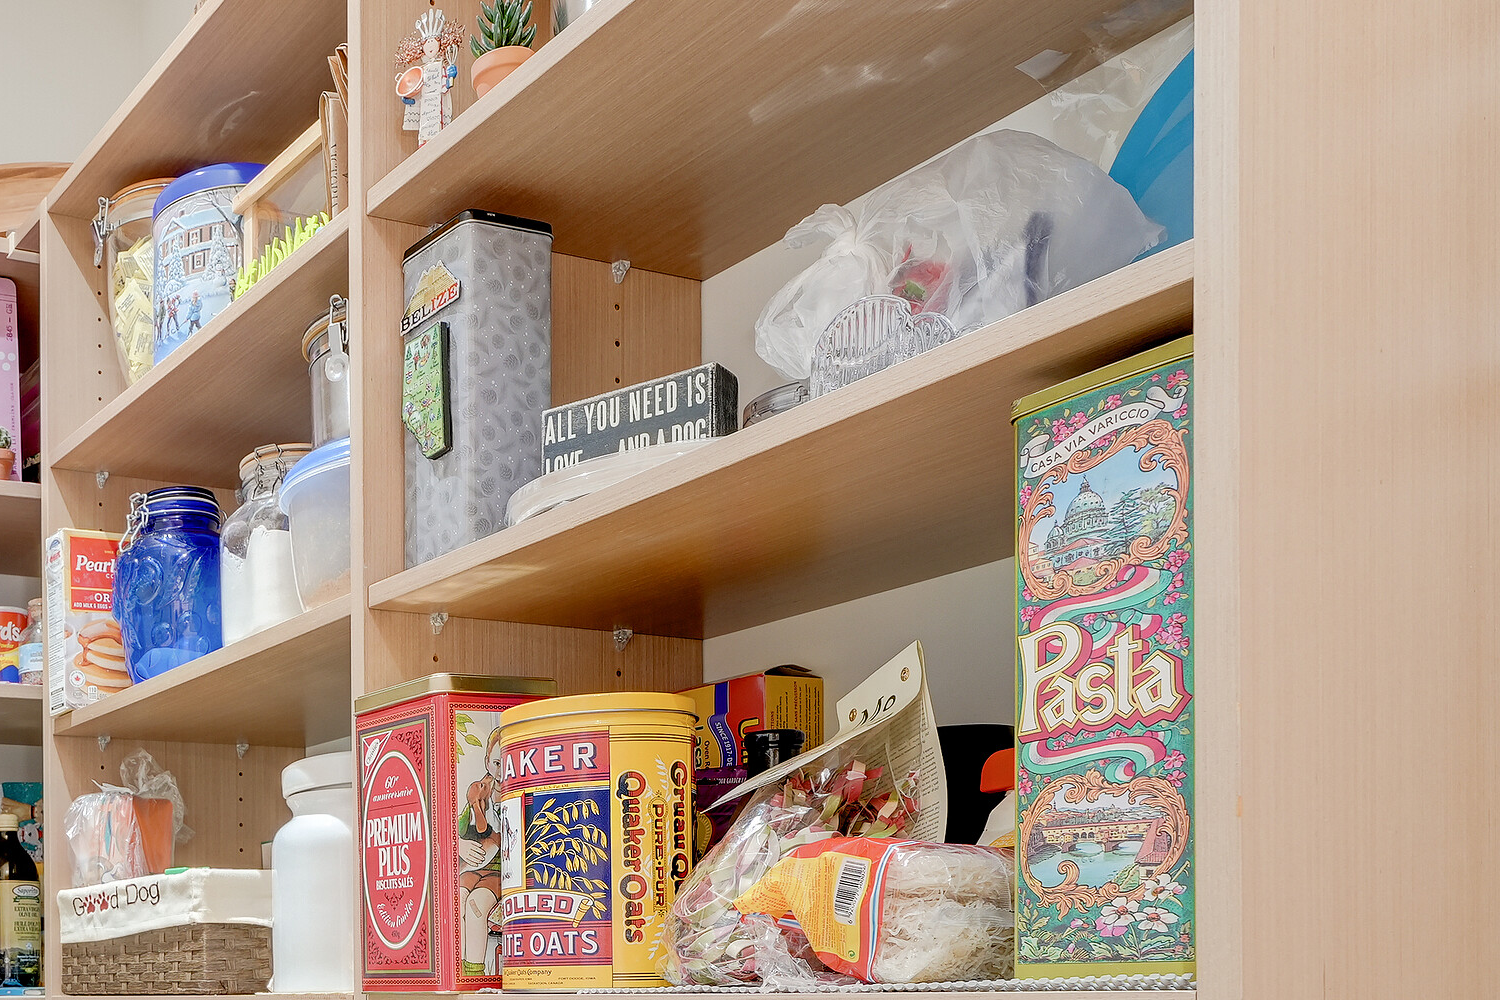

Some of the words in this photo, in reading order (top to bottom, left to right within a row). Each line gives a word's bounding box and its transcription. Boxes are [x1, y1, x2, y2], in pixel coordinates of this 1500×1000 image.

[401, 282, 458, 333] BELIZE
[545, 410, 577, 446] ALL
[583, 396, 620, 435] YOU
[629, 380, 678, 423] NEED
[687, 372, 706, 408] IS
[672, 418, 707, 443] DOG
[1031, 451, 1063, 474] CASA
[1064, 435, 1087, 453] VIA
[1088, 407, 1150, 437] VARICCIO
[75, 553, 116, 574] Pearl
[1017, 621, 1186, 738] Pasta
[714, 721, 729, 741] SINCE
[372, 785, 414, 803] anniversaire
[670, 760, 688, 854] Gruau
[367, 810, 423, 849] PREMIUM
[616, 770, 647, 874] Quaker
[378, 844, 411, 878] PLUS
[125, 880, 160, 906] Dog
[376, 878, 397, 891] BISCUITS
[618, 873, 648, 944] Oats
[530, 930, 598, 956] OATS
[527, 967, 553, 977] Company
